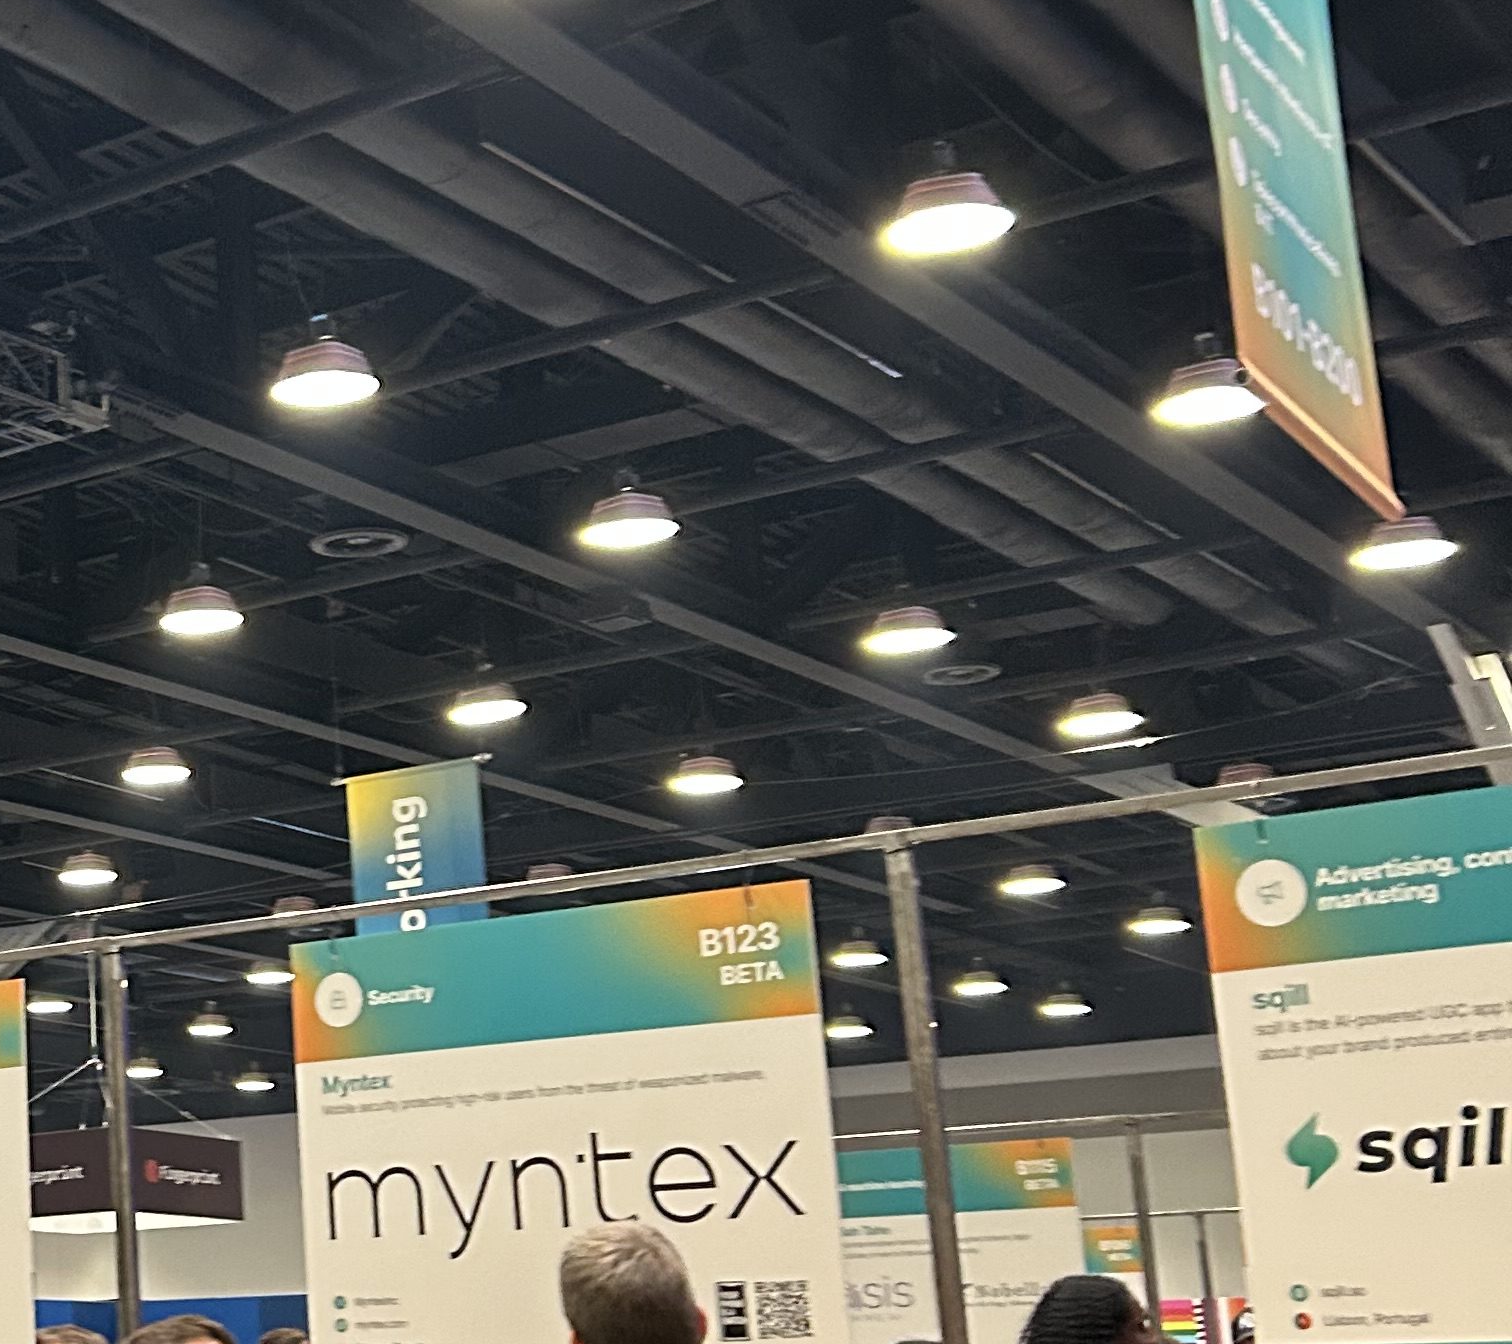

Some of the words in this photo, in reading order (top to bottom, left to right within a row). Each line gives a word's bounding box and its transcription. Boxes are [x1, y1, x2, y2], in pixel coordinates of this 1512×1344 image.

[1315, 854, 1462, 886] Advertising,
[1316, 882, 1441, 911] marketing
[698, 921, 781, 957] B123
[719, 960, 785, 986] BETA
[367, 984, 436, 1006] Security
[321, 1074, 393, 1098] Myntex
[1356, 1106, 1506, 1184] sqil
[325, 1131, 807, 1260] myntex
